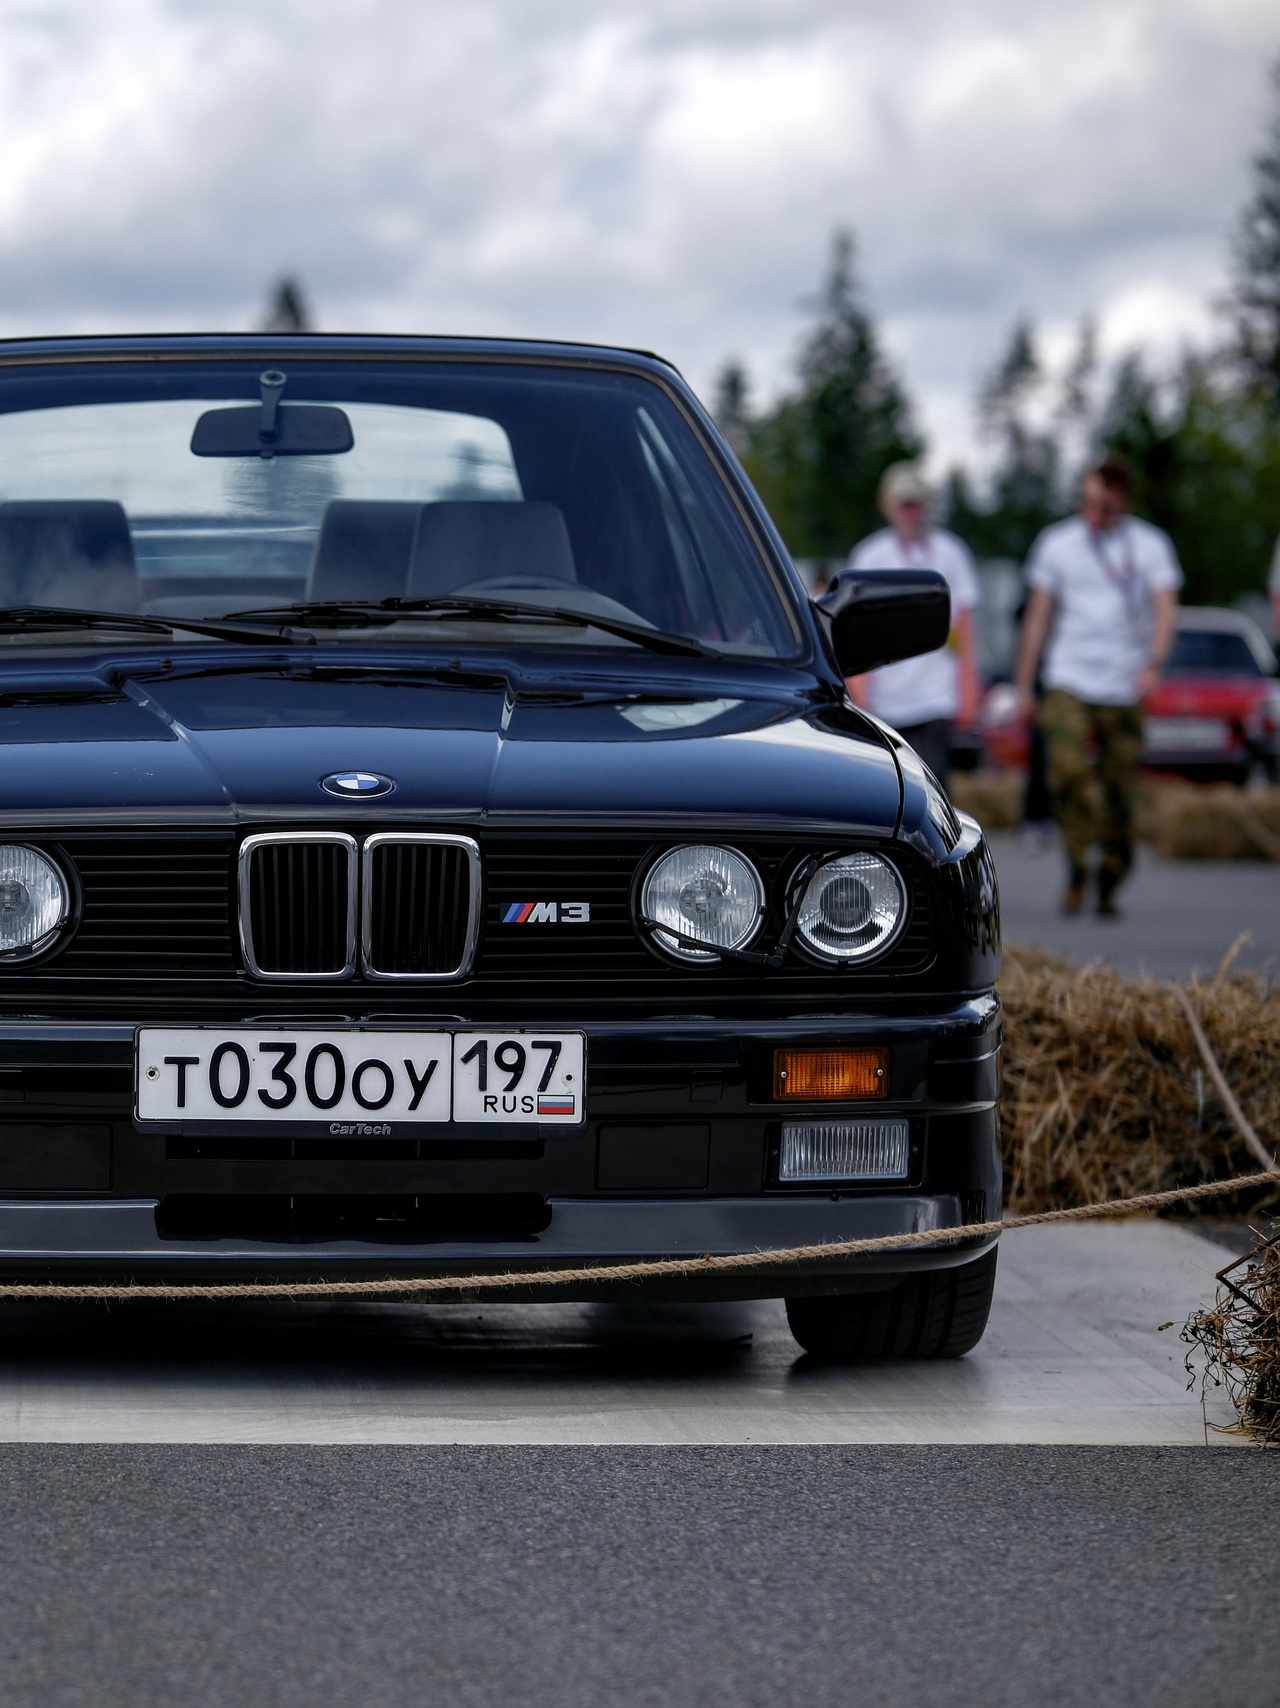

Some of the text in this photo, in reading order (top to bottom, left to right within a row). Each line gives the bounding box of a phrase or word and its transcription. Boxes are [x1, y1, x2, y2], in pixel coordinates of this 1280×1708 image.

[527, 902, 590, 923] M3
[460, 1039, 562, 1093] 197
[483, 1095, 534, 1113] RUS
[329, 1122, 392, 1136] CarTech
